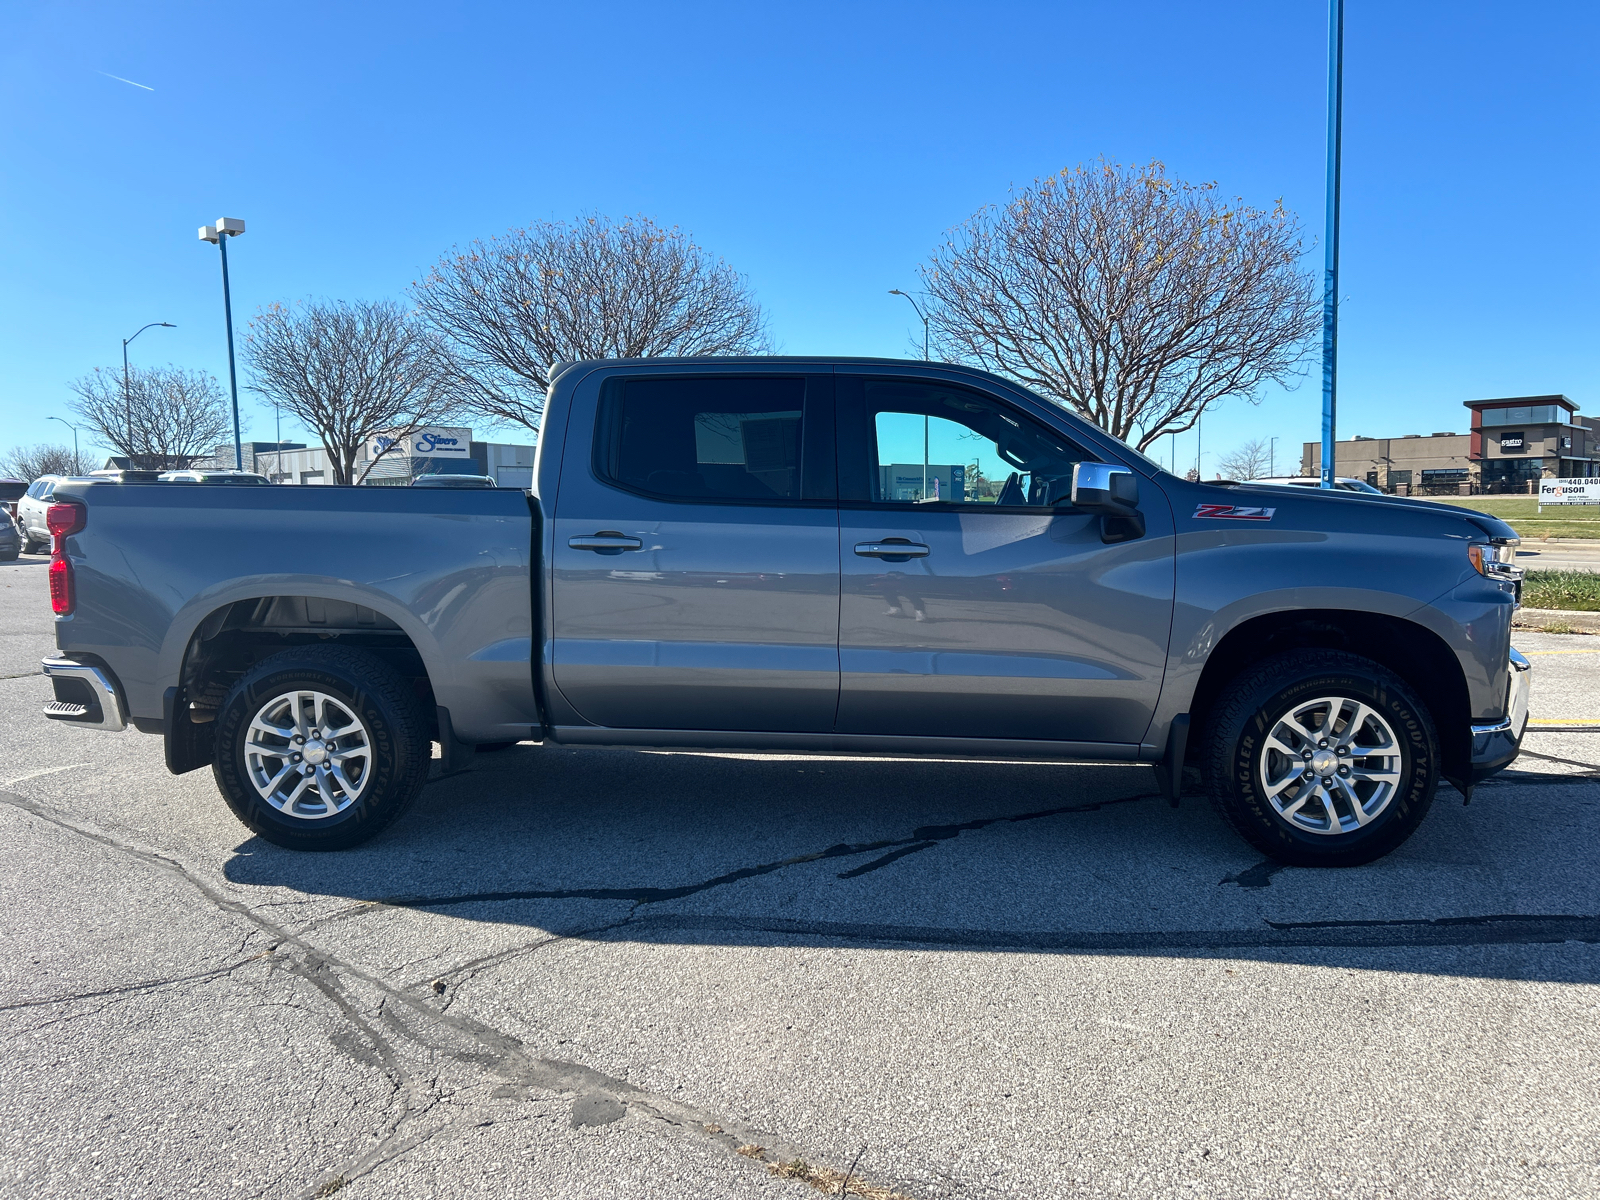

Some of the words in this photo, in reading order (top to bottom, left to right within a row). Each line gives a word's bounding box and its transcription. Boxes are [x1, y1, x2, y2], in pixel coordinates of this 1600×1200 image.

[415, 433, 458, 452] Stivers
[1501, 438, 1523, 447] gastro
[1541, 485, 1585, 497] Ferguson
[1191, 503, 1277, 522] Z71
[221, 708, 244, 799] WRANGLER
[1238, 735, 1272, 827] WRANGLER
